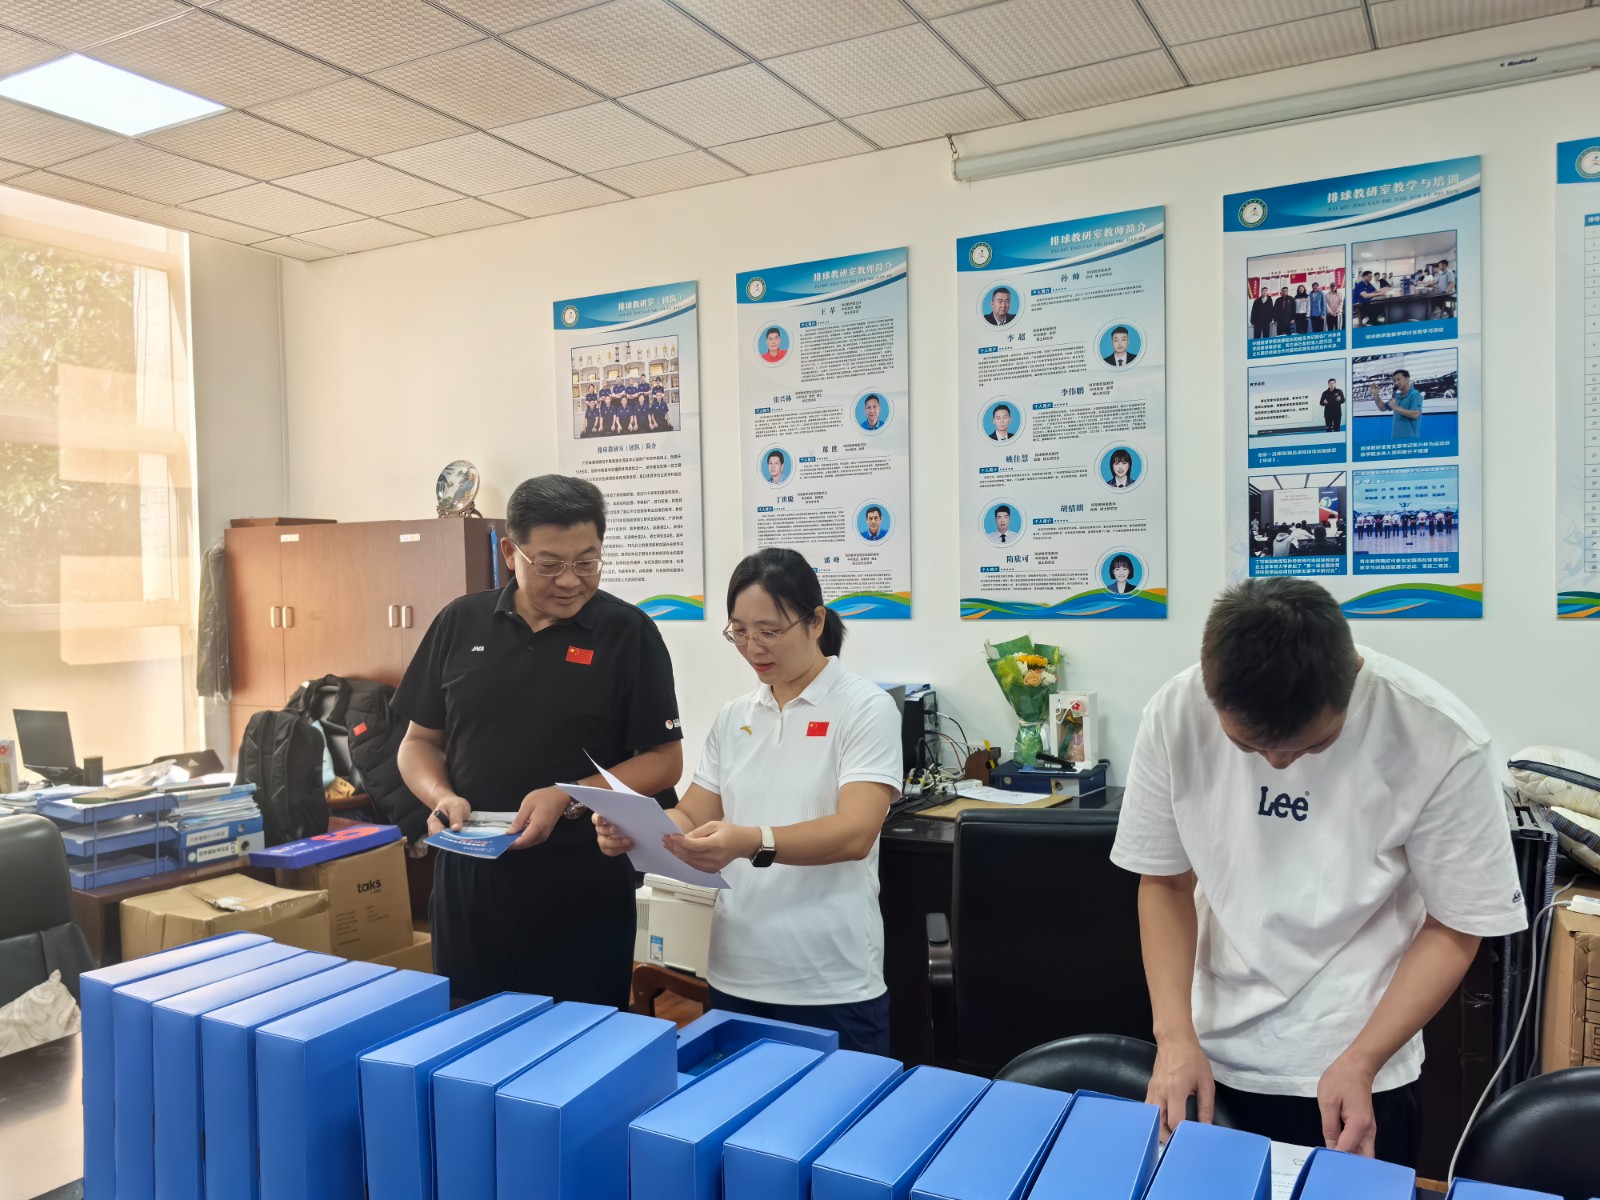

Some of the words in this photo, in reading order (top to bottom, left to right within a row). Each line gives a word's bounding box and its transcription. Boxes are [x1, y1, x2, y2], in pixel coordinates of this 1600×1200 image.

[1327, 174, 1459, 204] 排球教研室教学与培训
[1050, 223, 1146, 247] 排球教研室教师简介
[813, 261, 892, 282] 排球教研室教师简介
[1006, 554, 1029, 563] 隋欣可
[1258, 786, 1309, 822] Lee
[357, 880, 382, 893] taks
